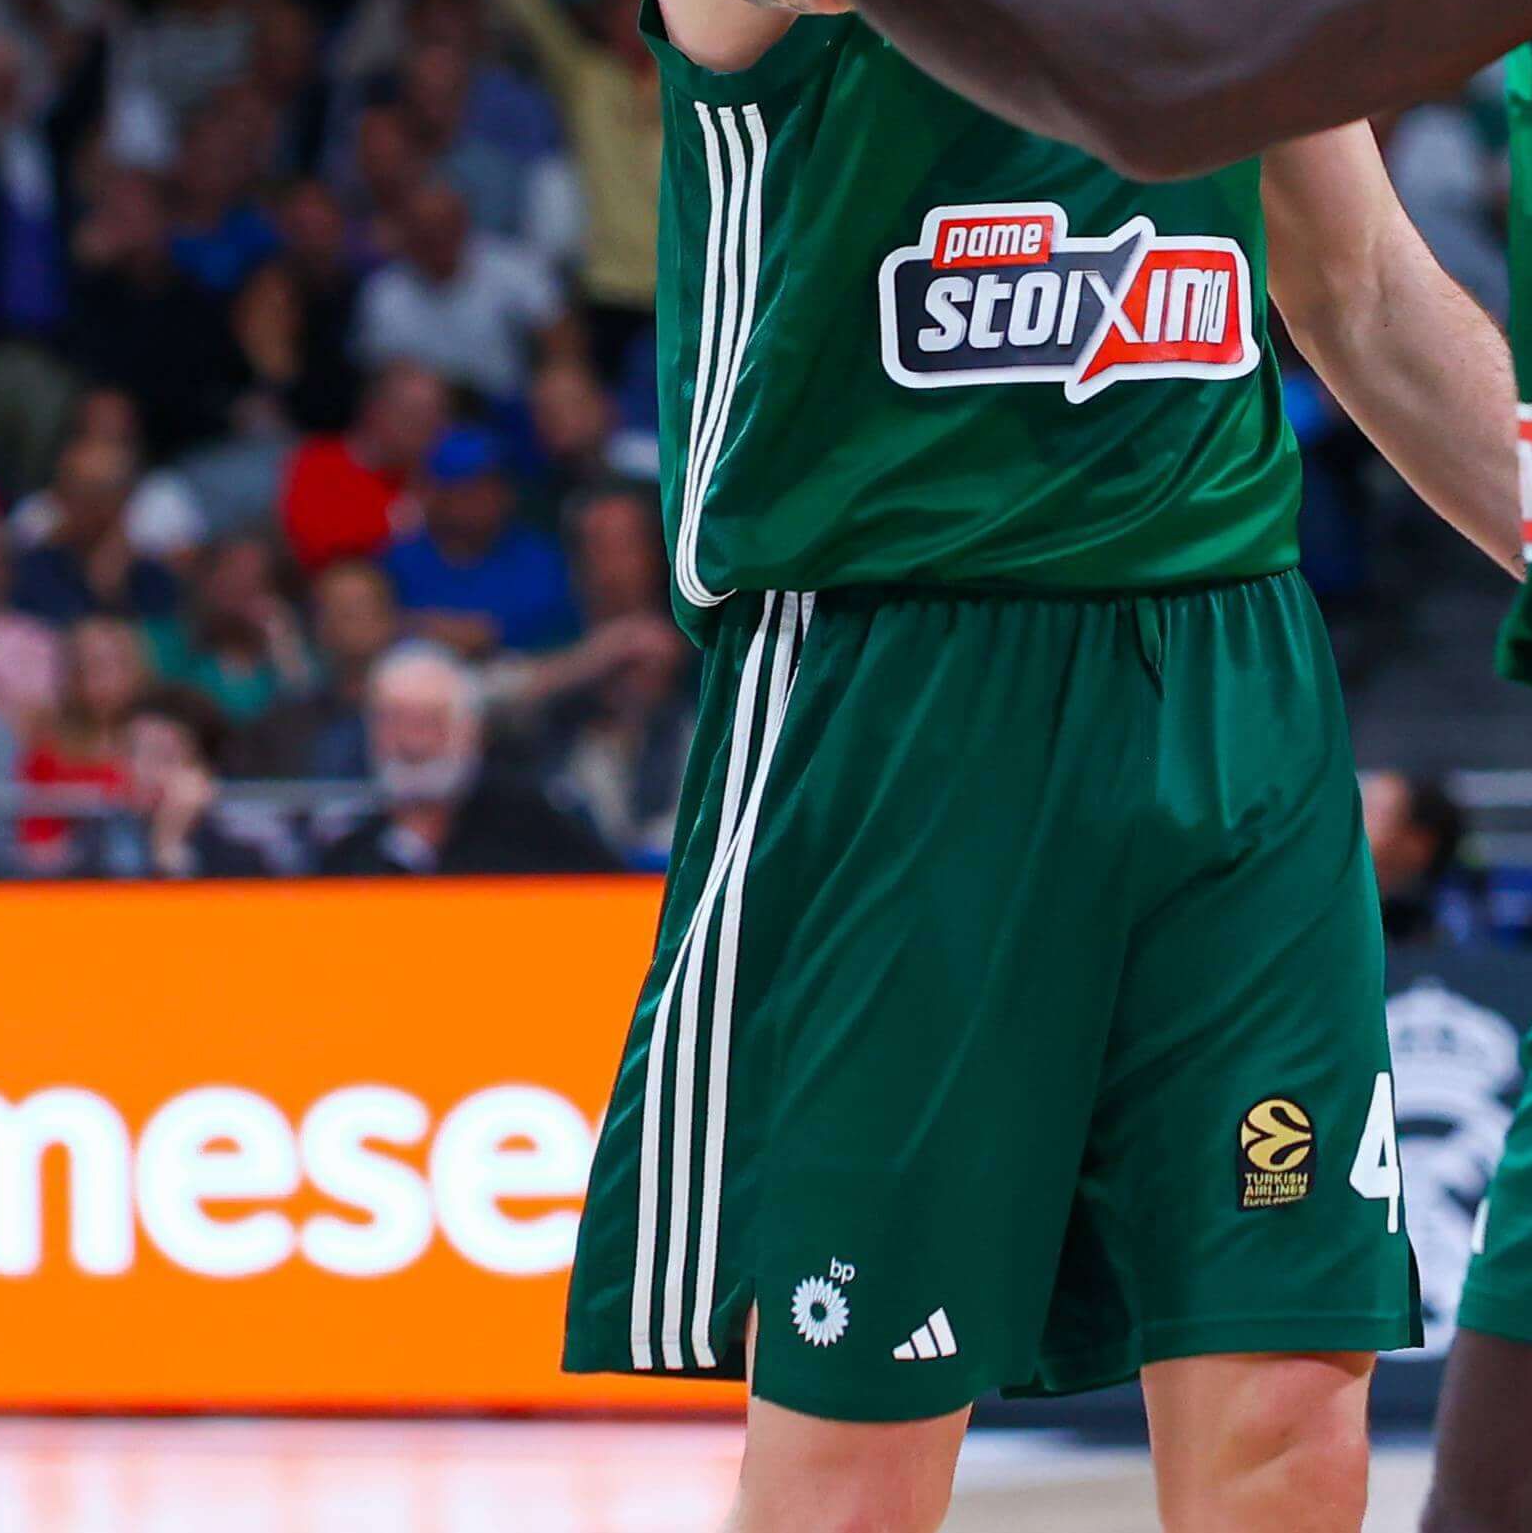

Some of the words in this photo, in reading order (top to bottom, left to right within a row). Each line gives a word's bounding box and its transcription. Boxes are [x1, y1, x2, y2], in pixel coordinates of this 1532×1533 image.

[943, 223, 1044, 264] pame
[1244, 1172, 1308, 1185] TURKISH
[829, 1256, 856, 1285] bp
